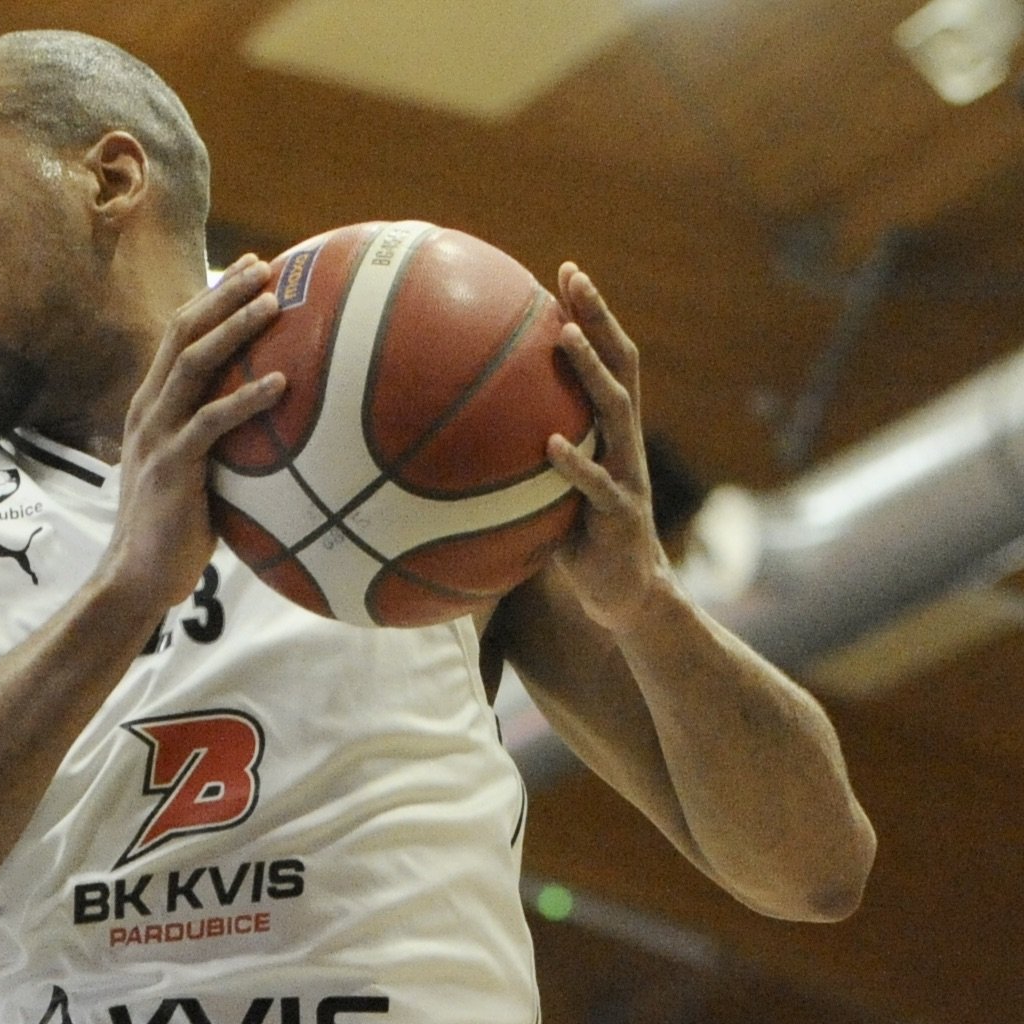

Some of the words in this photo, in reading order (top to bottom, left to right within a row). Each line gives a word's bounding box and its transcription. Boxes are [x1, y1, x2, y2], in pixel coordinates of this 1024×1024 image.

[73, 874, 153, 925] BK
[166, 859, 305, 912] KVIS
[109, 912, 271, 947] PARDUBICE
